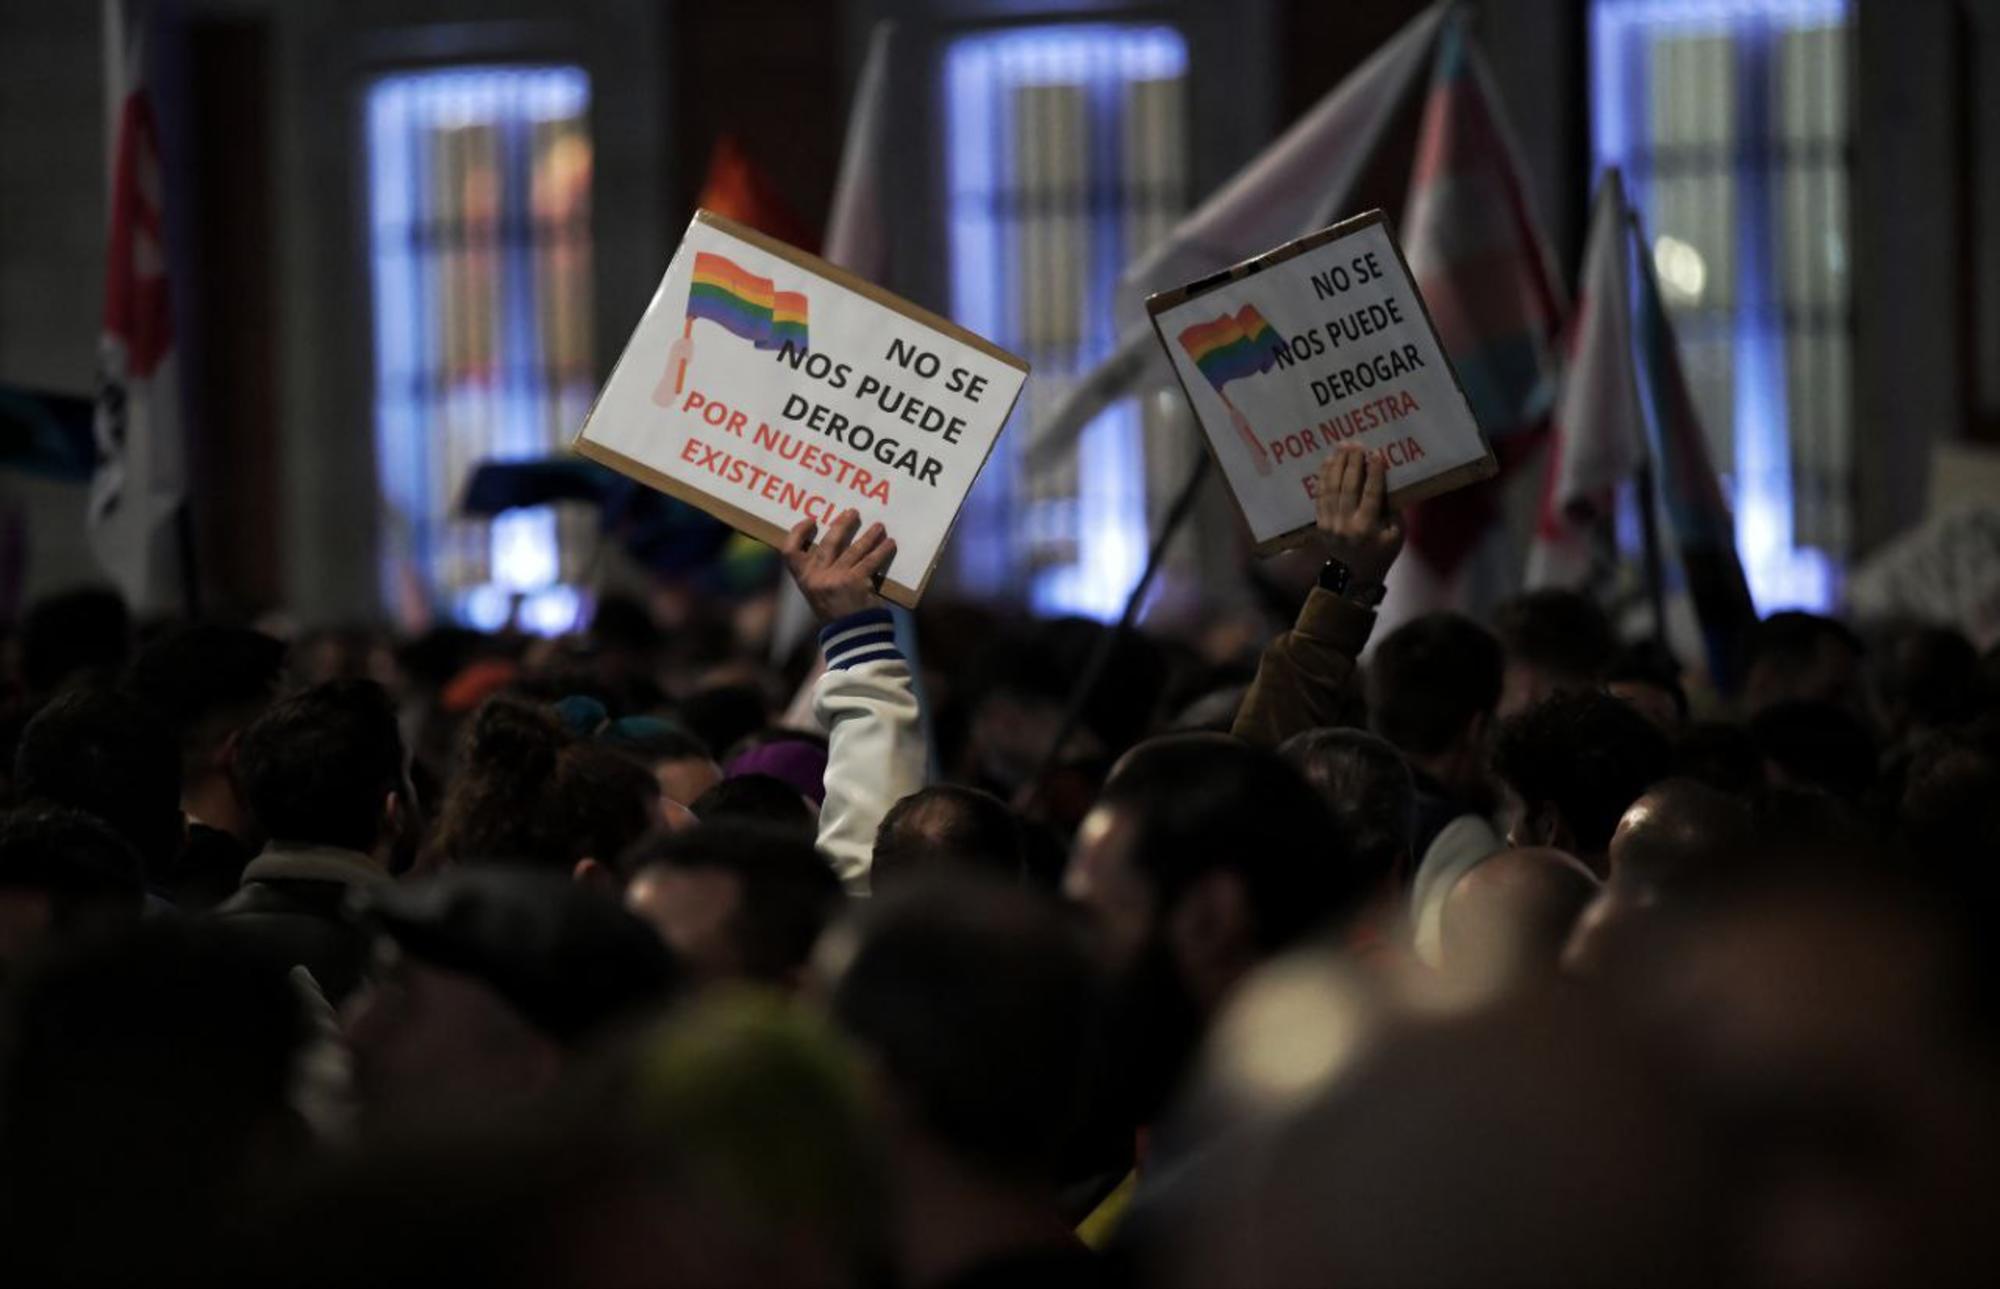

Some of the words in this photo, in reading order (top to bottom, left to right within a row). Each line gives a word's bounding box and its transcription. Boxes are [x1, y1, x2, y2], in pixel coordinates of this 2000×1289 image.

[1311, 266, 1349, 300] NO
[1352, 252, 1382, 284] SE
[885, 338, 940, 379] NO
[945, 367, 988, 402] SE
[1272, 329, 1325, 370] NOS
[1326, 298, 1403, 348] PUEDE
[776, 339, 852, 388] NOS
[856, 375, 966, 444] PUEDE
[1311, 344, 1425, 407] DEROGAR
[683, 391, 747, 437] POR
[753, 423, 890, 505] NUESTRA
[781, 394, 943, 487] DEROGAR
[1270, 428, 1320, 465] POR
[1319, 390, 1420, 446] NUESTRA
[680, 438, 841, 526] EXISTENCI
